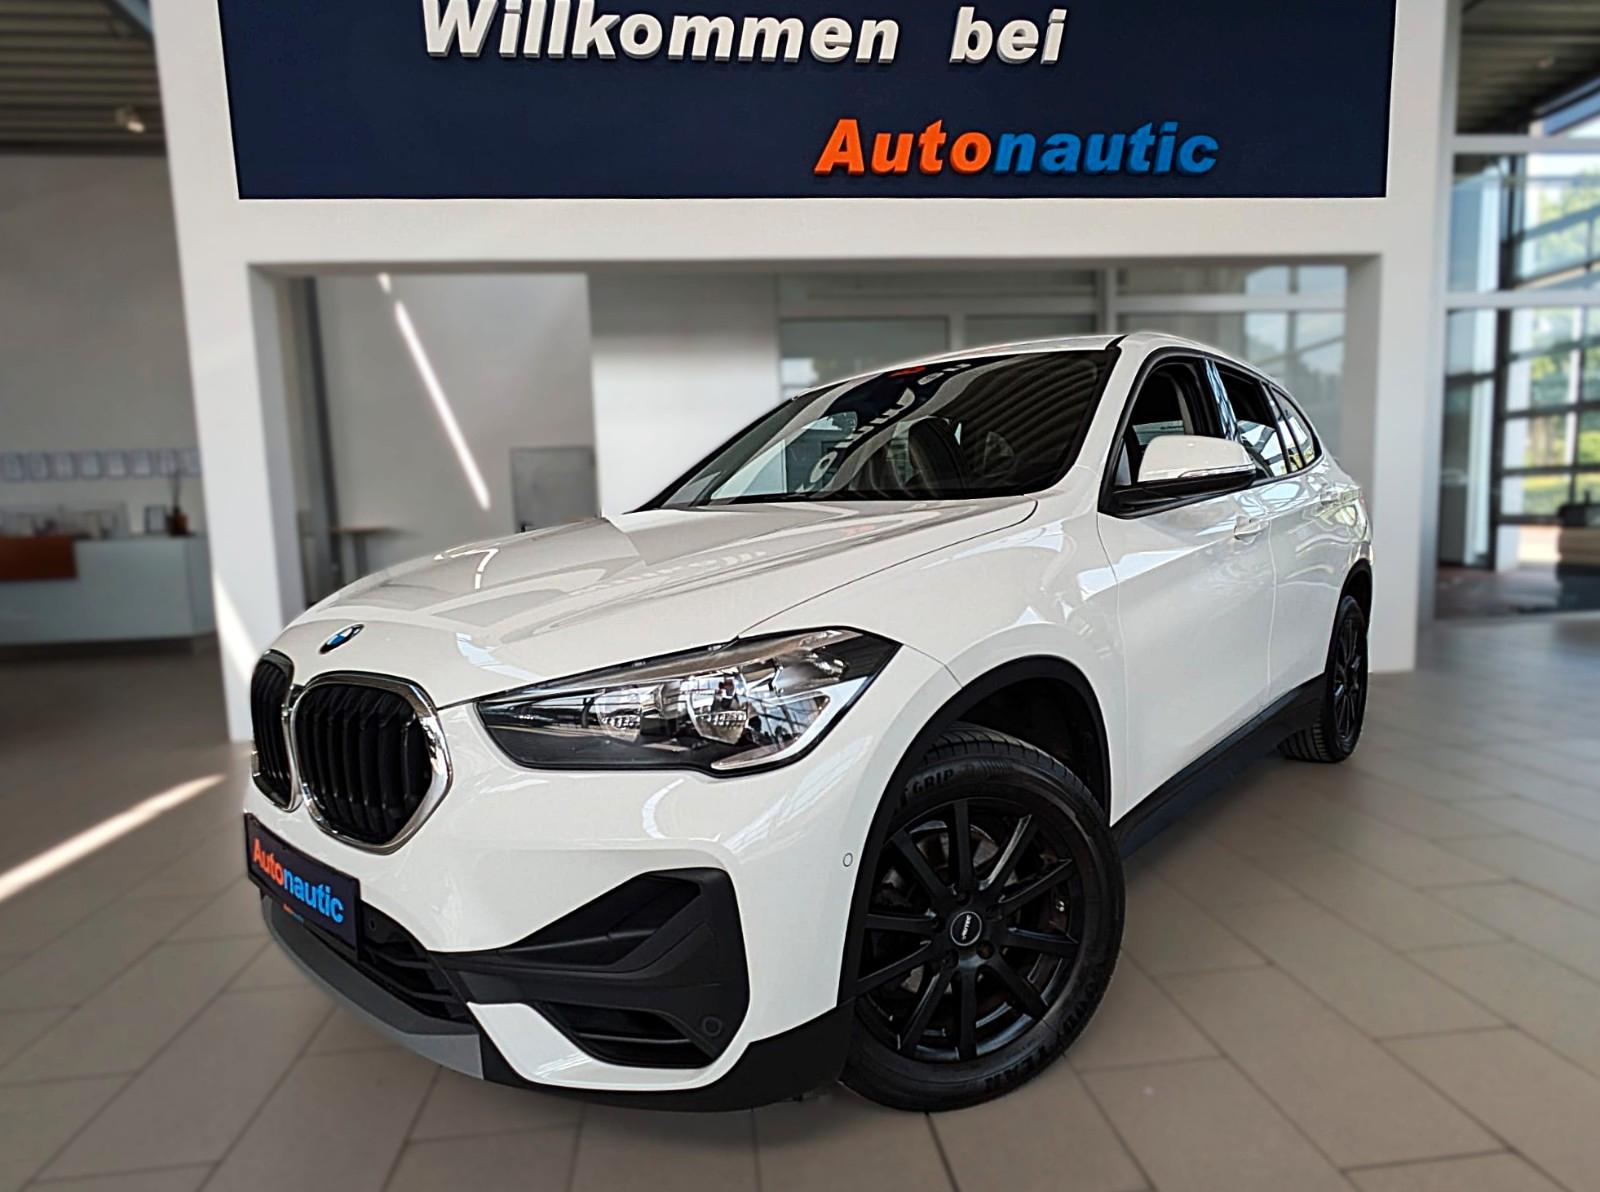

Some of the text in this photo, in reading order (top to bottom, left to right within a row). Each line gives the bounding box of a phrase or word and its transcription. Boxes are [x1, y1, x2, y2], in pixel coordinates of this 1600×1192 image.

[423, 0, 1067, 65] Willkommen bei
[814, 118, 1219, 177] Autonautic
[253, 839, 344, 923] Autonautic
